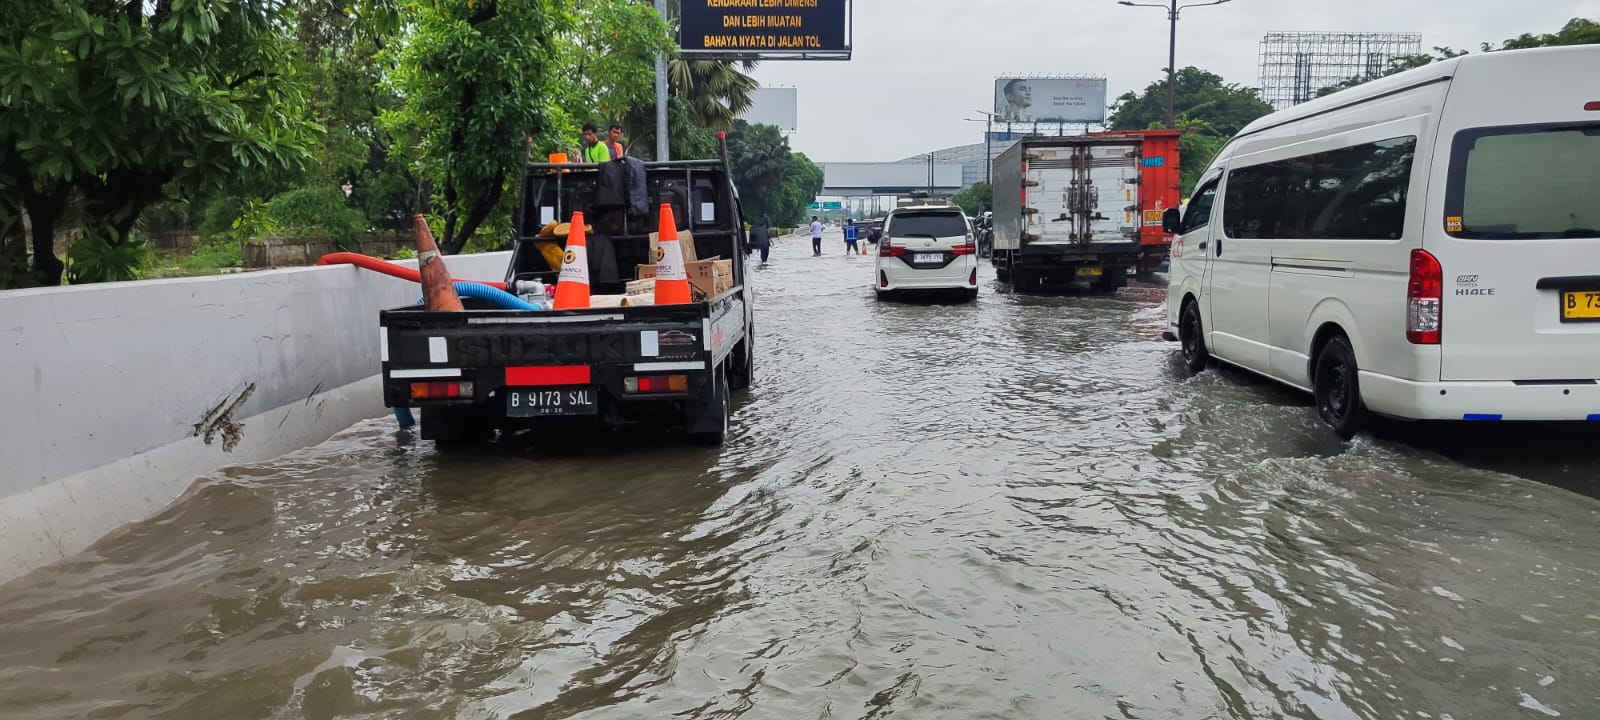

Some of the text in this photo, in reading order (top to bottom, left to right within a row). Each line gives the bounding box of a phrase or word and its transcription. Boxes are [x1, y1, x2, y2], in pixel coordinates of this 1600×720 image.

[707, 0, 818, 8] KENDARAAN LEBIH DIMENSI
[723, 15, 802, 28] DAN LEBIH MUATAN
[704, 35, 821, 48] BAHAYA NYATA DI JALAN TOL
[1456, 275, 1479, 283] BRN
[1455, 288, 1496, 296] HIACE
[1567, 294, 1577, 309] B
[456, 334, 636, 361] SUZUKI
[511, 390, 593, 407] B 9173 SAL
